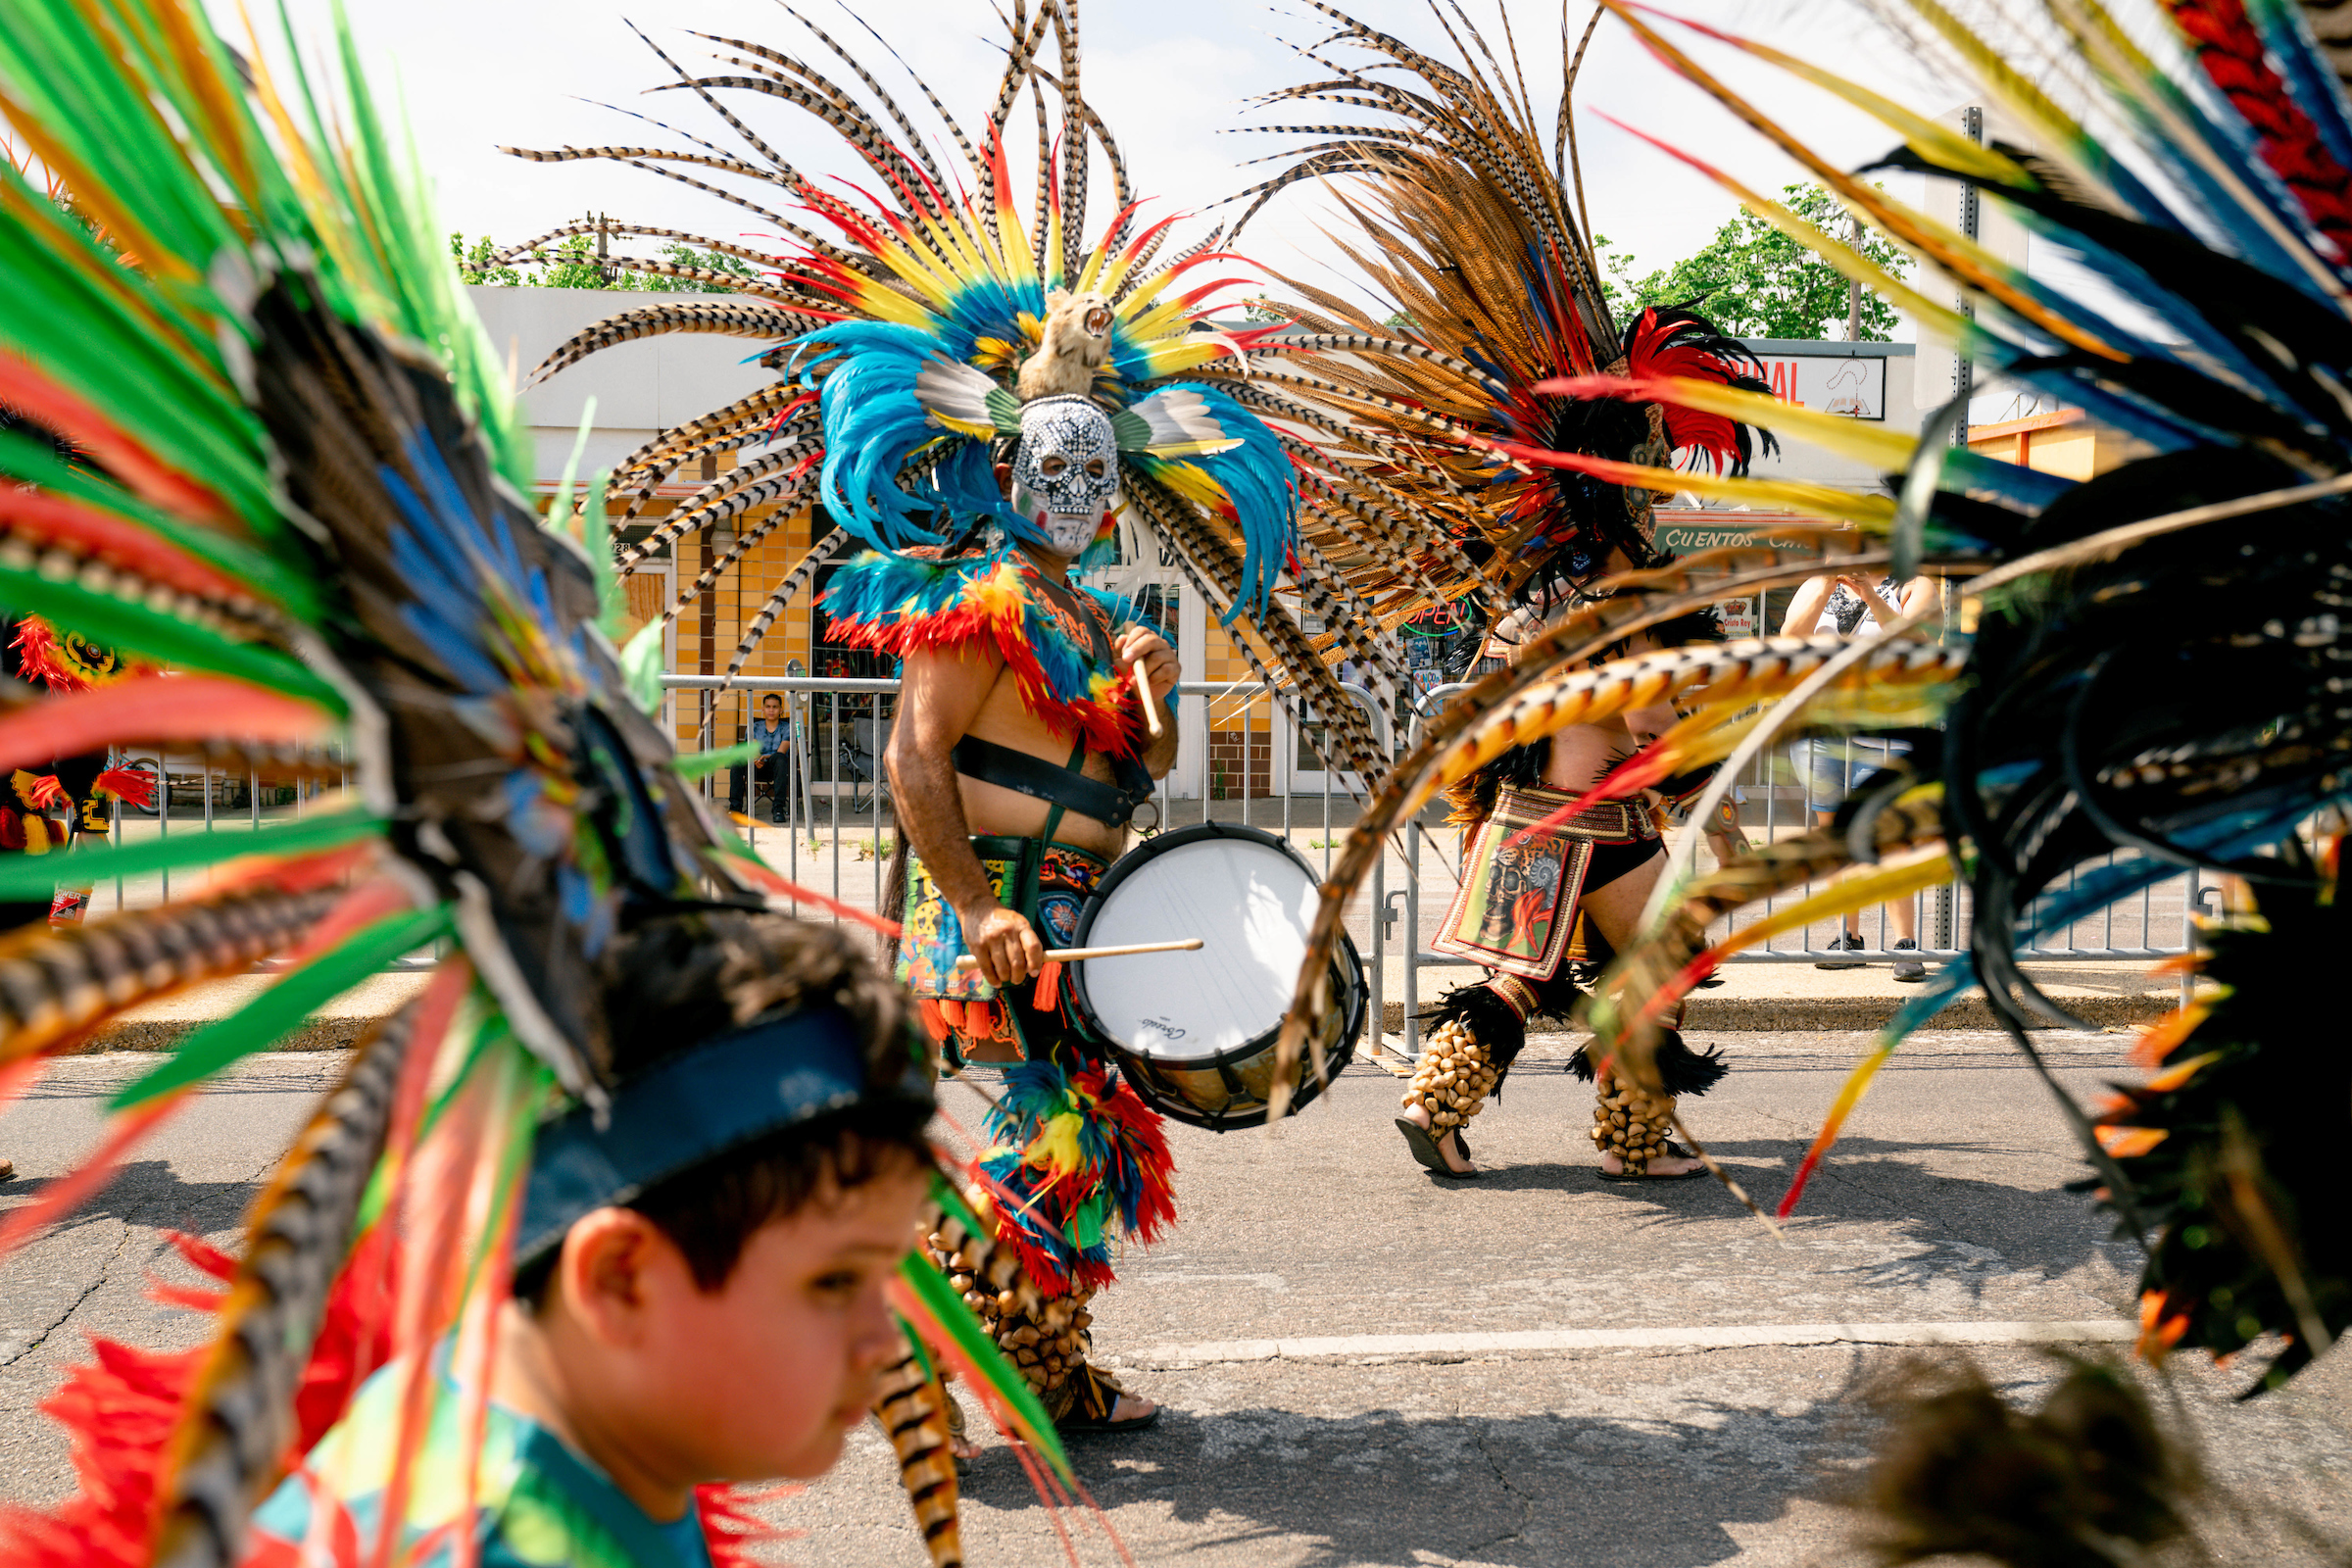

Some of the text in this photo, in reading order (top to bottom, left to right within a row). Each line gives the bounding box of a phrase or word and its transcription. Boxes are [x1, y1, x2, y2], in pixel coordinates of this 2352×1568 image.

[1665, 528, 1757, 548] CUENTOS
[1724, 617, 1751, 629] Cristo Rey
